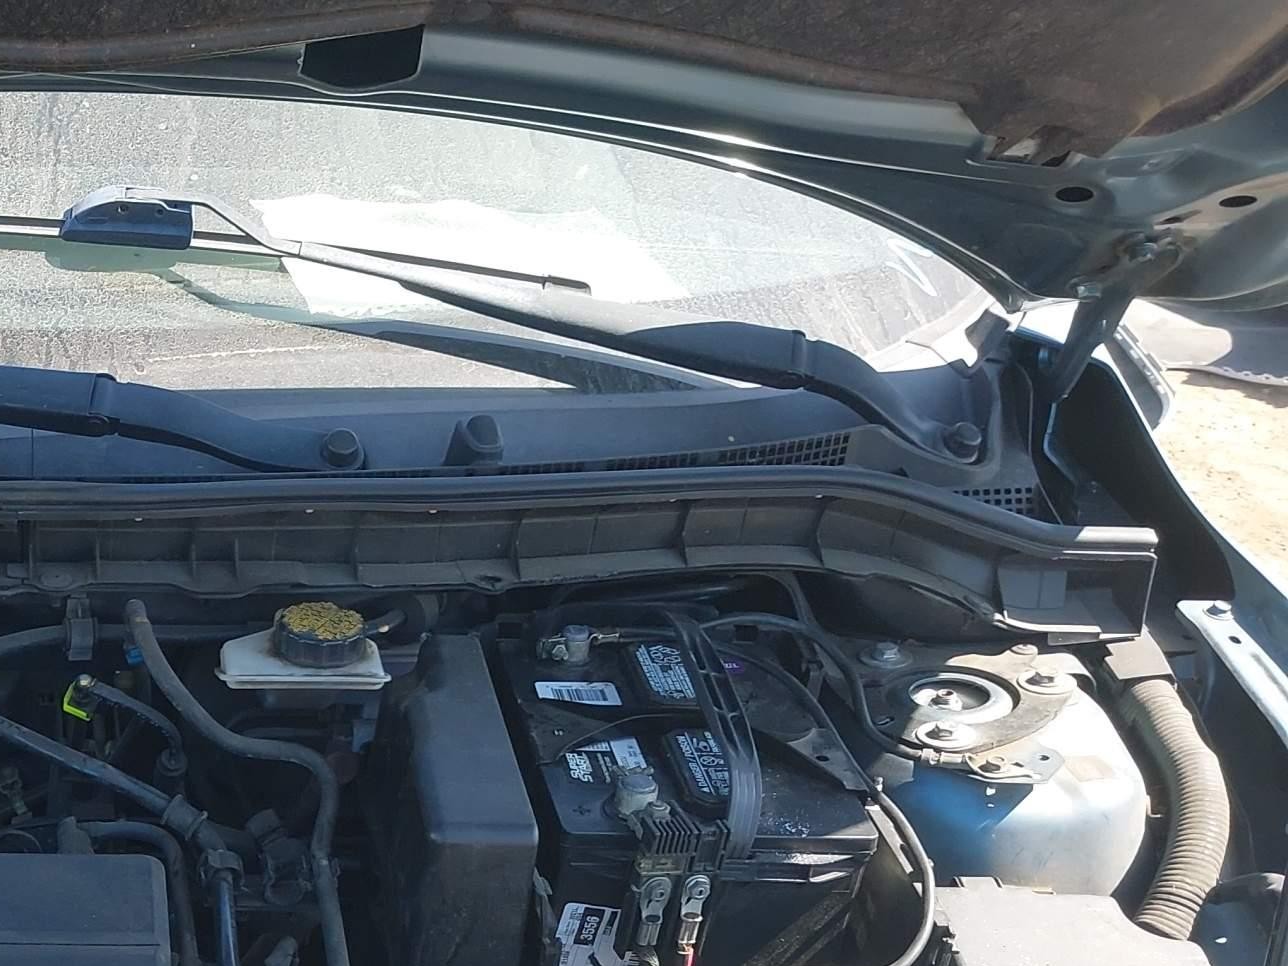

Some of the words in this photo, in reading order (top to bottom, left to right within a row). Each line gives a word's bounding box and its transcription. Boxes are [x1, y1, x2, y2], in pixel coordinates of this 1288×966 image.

[565, 752, 579, 779] SUPER
[575, 752, 593, 783] START
[580, 915, 600, 941] 3556
